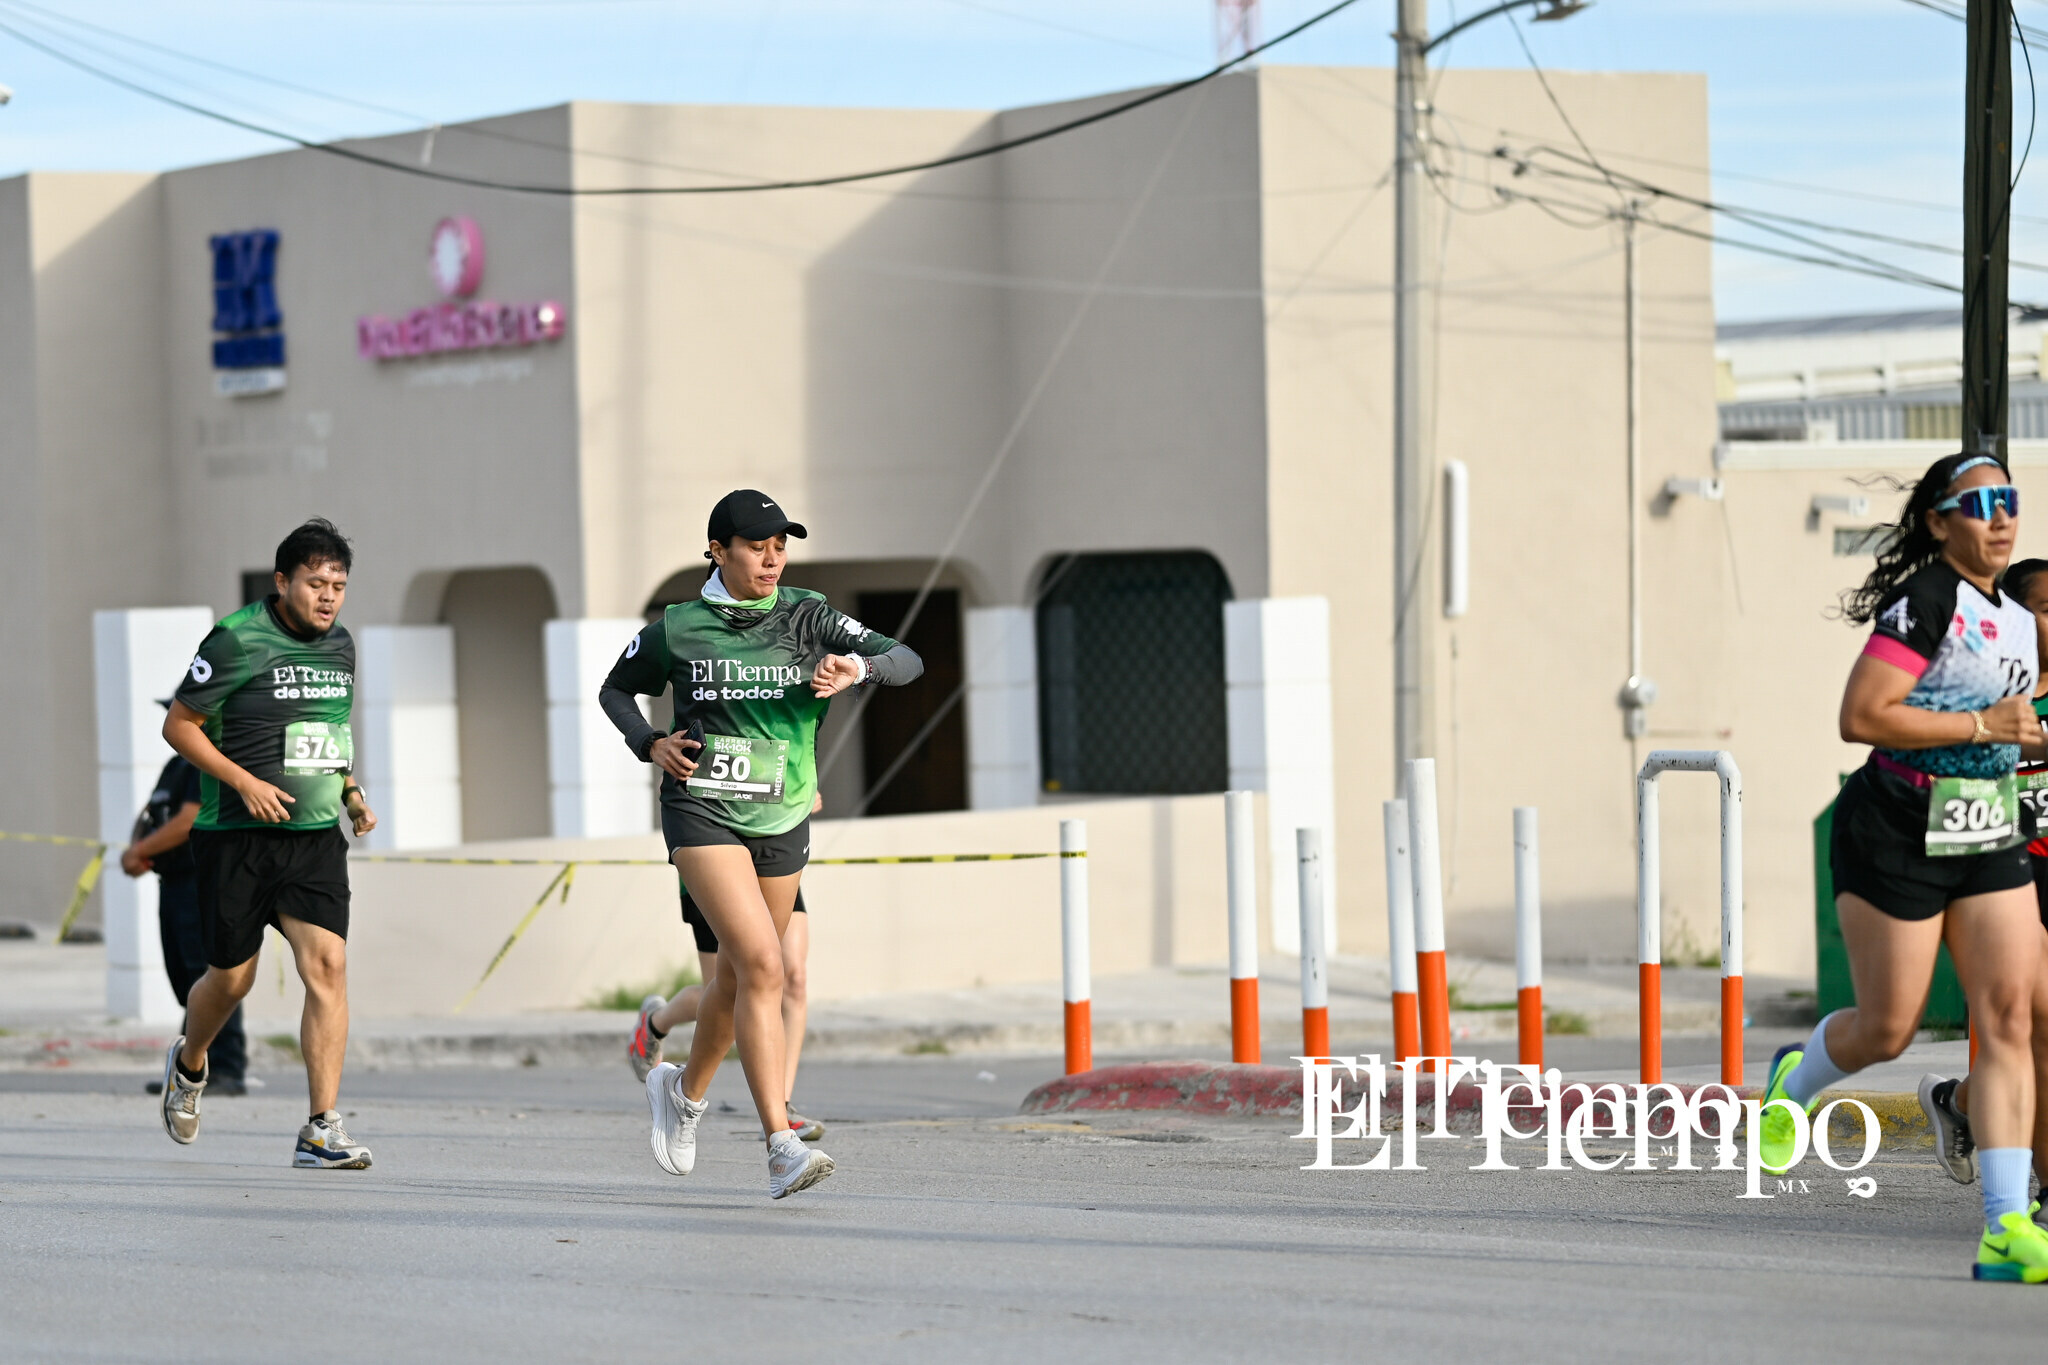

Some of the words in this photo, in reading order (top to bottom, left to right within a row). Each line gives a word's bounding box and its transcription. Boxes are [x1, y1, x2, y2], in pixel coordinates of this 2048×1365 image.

[273, 665, 296, 684] El
[688, 659, 714, 682] El
[717, 660, 801, 687] Tiempo
[274, 686, 301, 699] de
[302, 685, 348, 698] todos
[692, 687, 718, 700] de
[720, 686, 784, 700] todos
[295, 735, 340, 759] 576
[710, 753, 751, 782] 50
[774, 754, 785, 796] MEDALLA
[1943, 795, 2006, 832] 306
